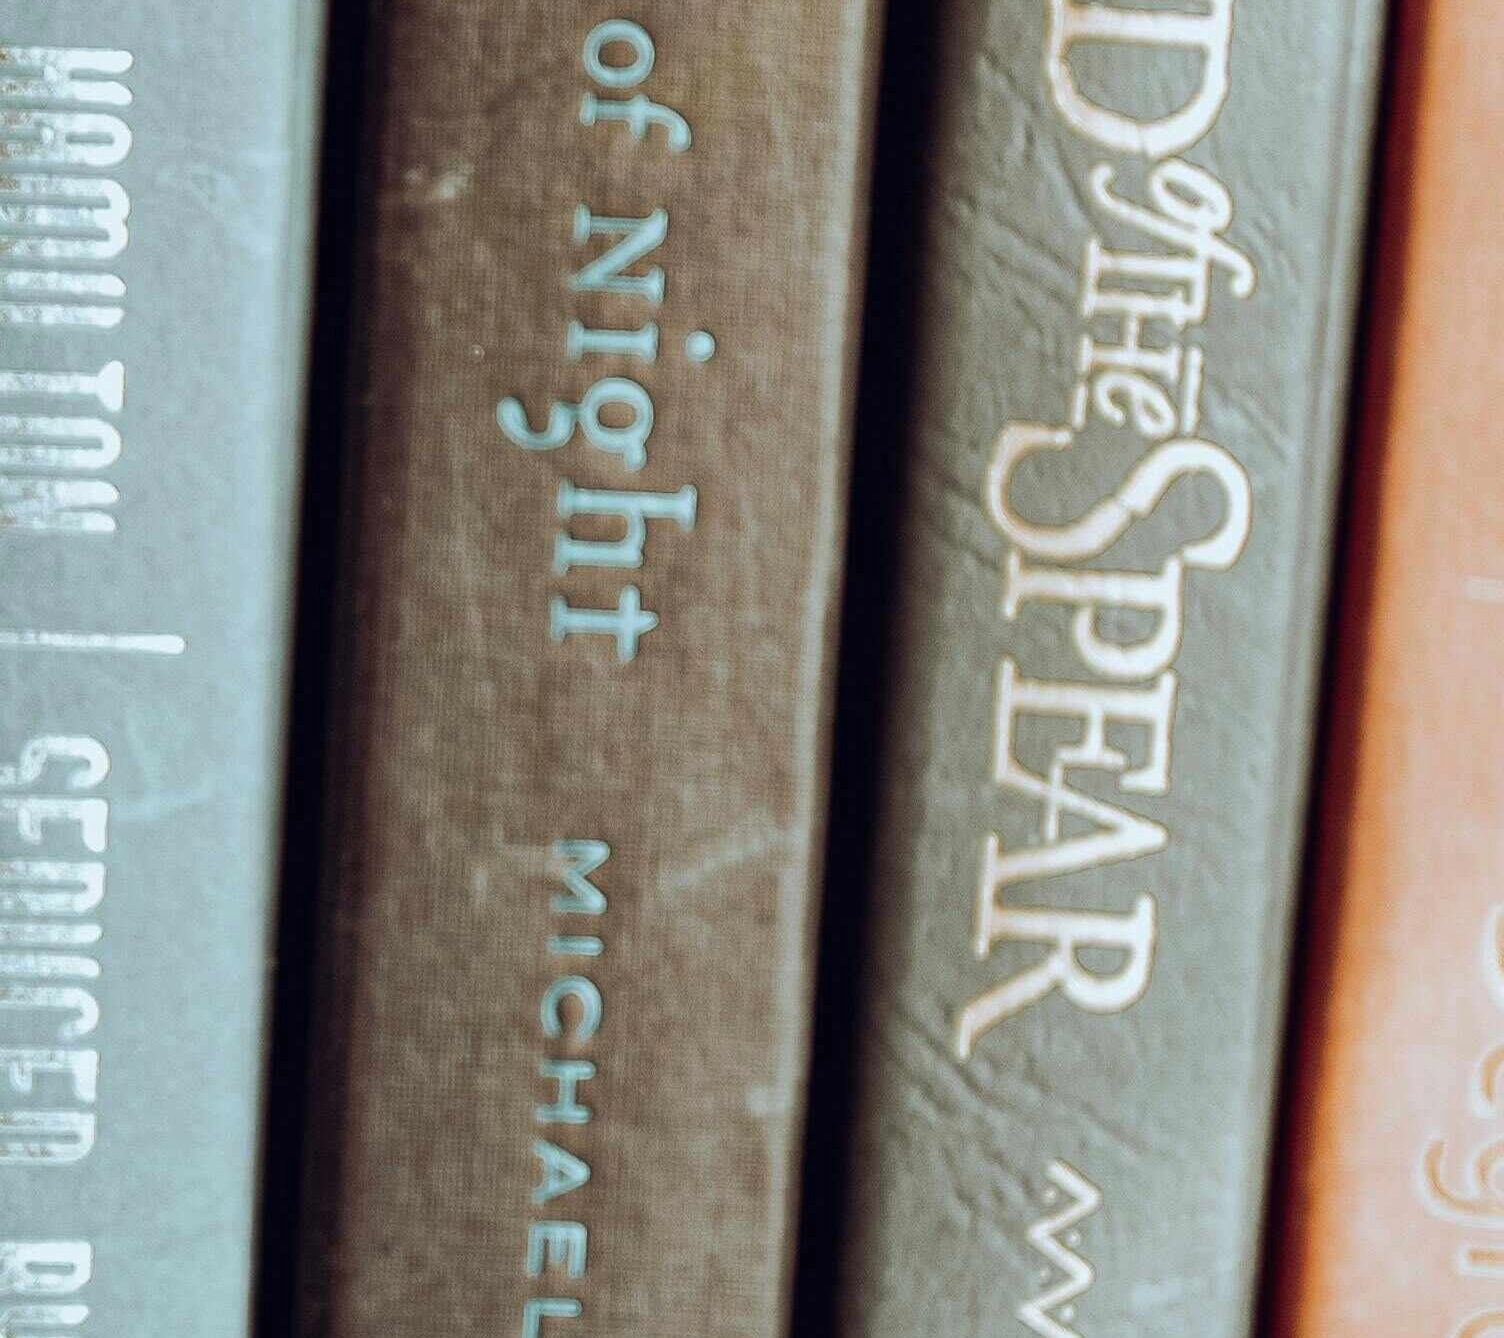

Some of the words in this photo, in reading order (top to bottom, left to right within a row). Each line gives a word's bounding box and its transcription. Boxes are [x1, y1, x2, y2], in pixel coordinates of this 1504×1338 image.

[580, 17, 694, 154] of
[1090, 154, 1256, 298] of
[495, 203, 716, 662] Night
[957, 418, 1254, 1060] SPEAR
